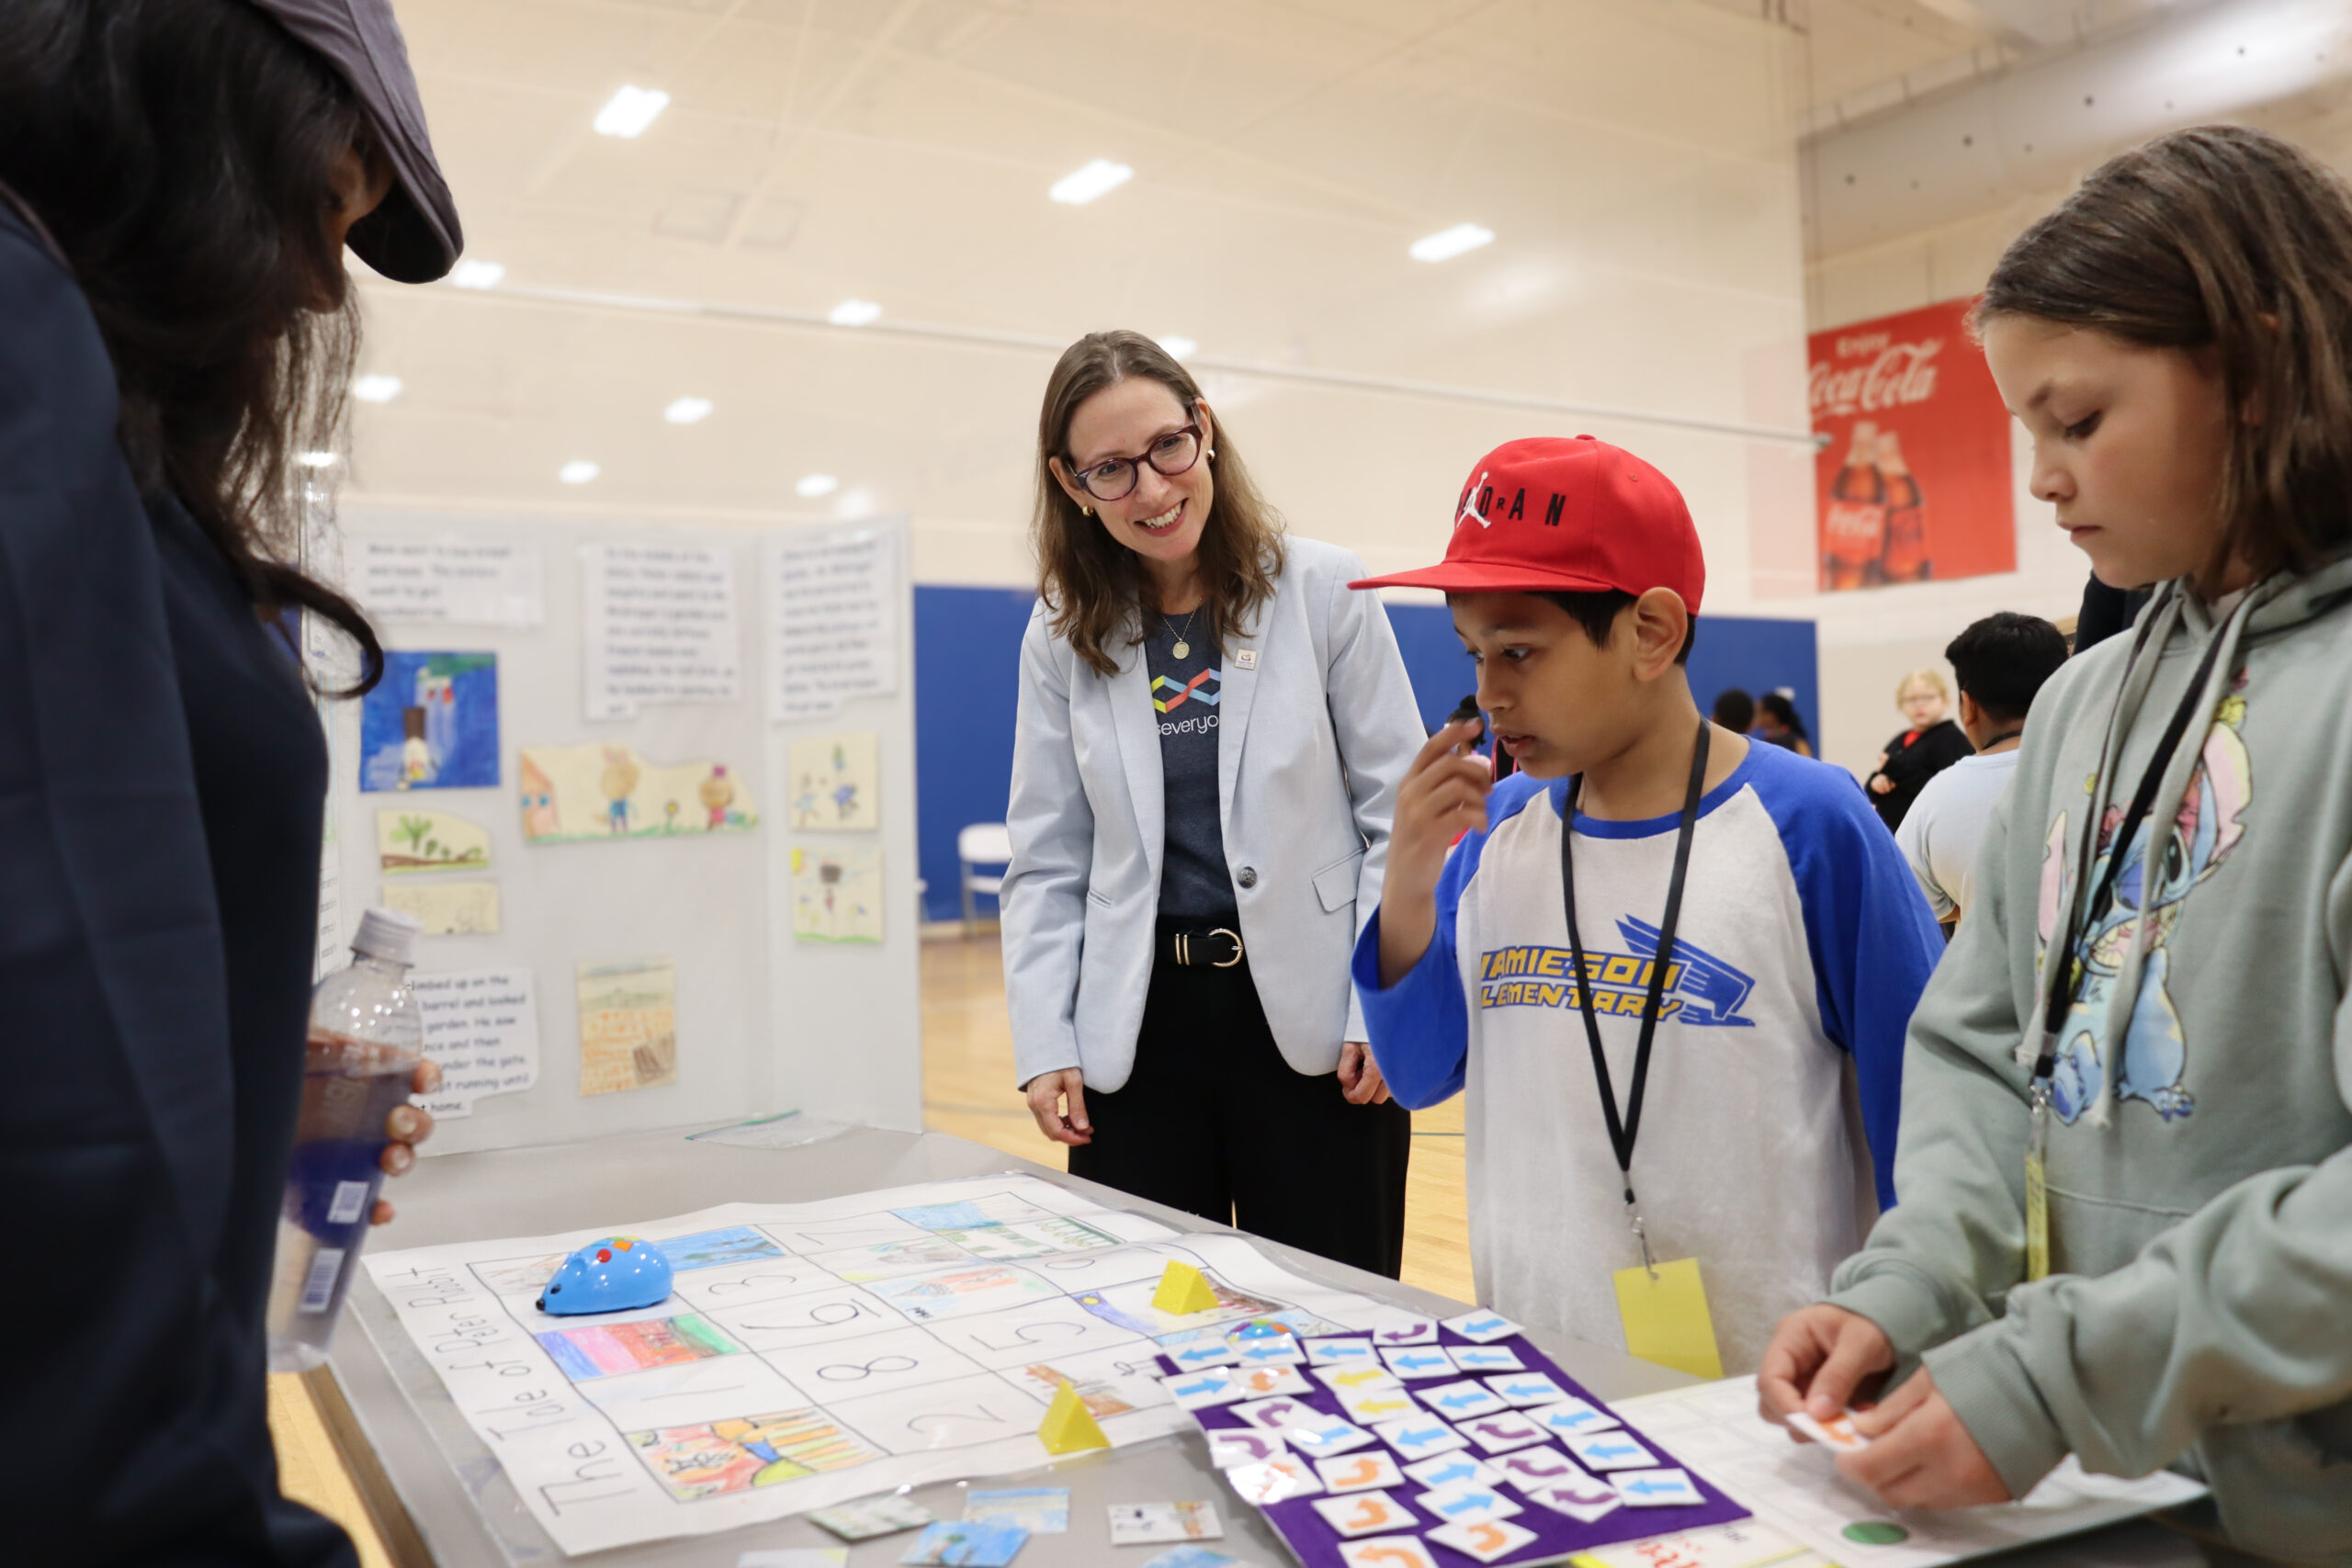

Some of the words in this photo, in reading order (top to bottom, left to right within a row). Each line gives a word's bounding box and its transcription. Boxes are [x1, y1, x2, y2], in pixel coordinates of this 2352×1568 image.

[384, 1266, 474, 1309] Rabbit
[427, 1312, 512, 1354] Peter
[448, 1359, 533, 1377] of
[816, 1355, 919, 1382] 8
[474, 1388, 579, 1443] Tale
[906, 1404, 1007, 1434] 2
[537, 1439, 639, 1517] The
